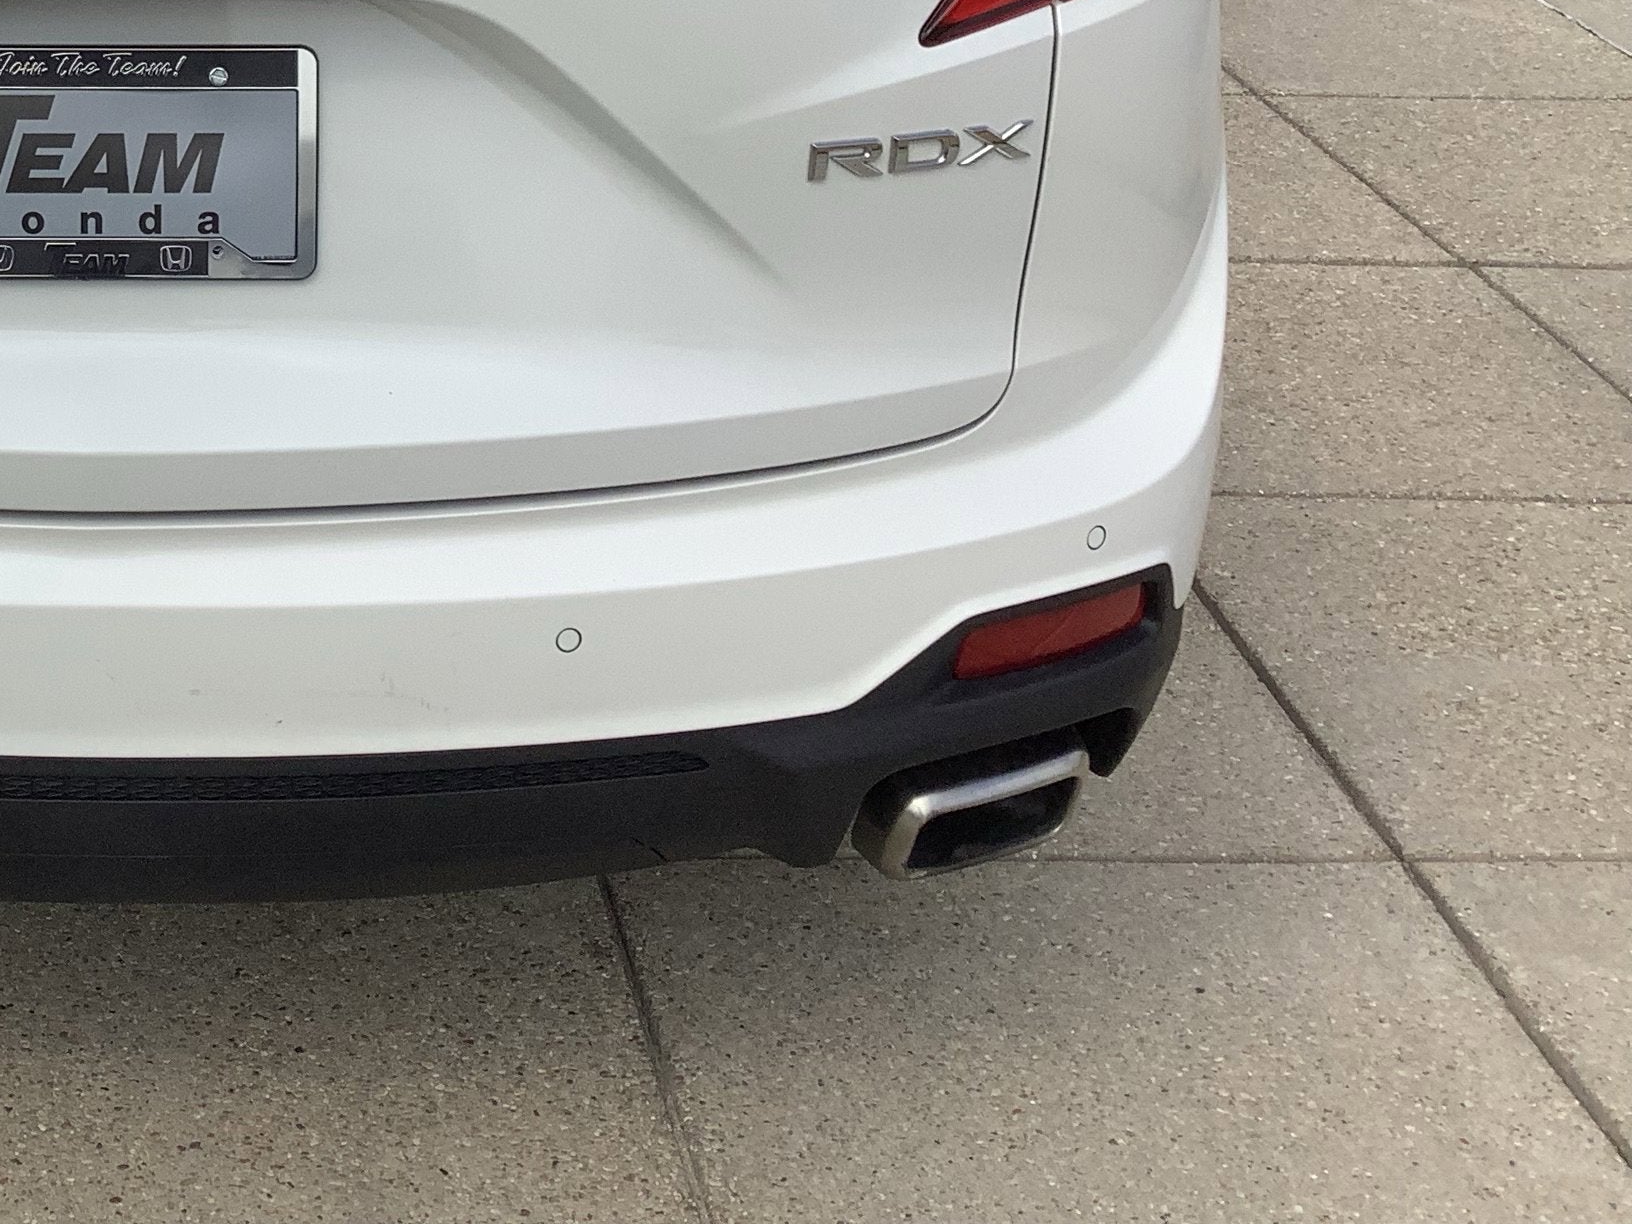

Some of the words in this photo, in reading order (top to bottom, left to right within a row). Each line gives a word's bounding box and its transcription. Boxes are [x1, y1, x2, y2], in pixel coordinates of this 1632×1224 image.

[51, 52, 100, 76] The
[103, 52, 187, 77] Team!
[807, 119, 1034, 182] RDX
